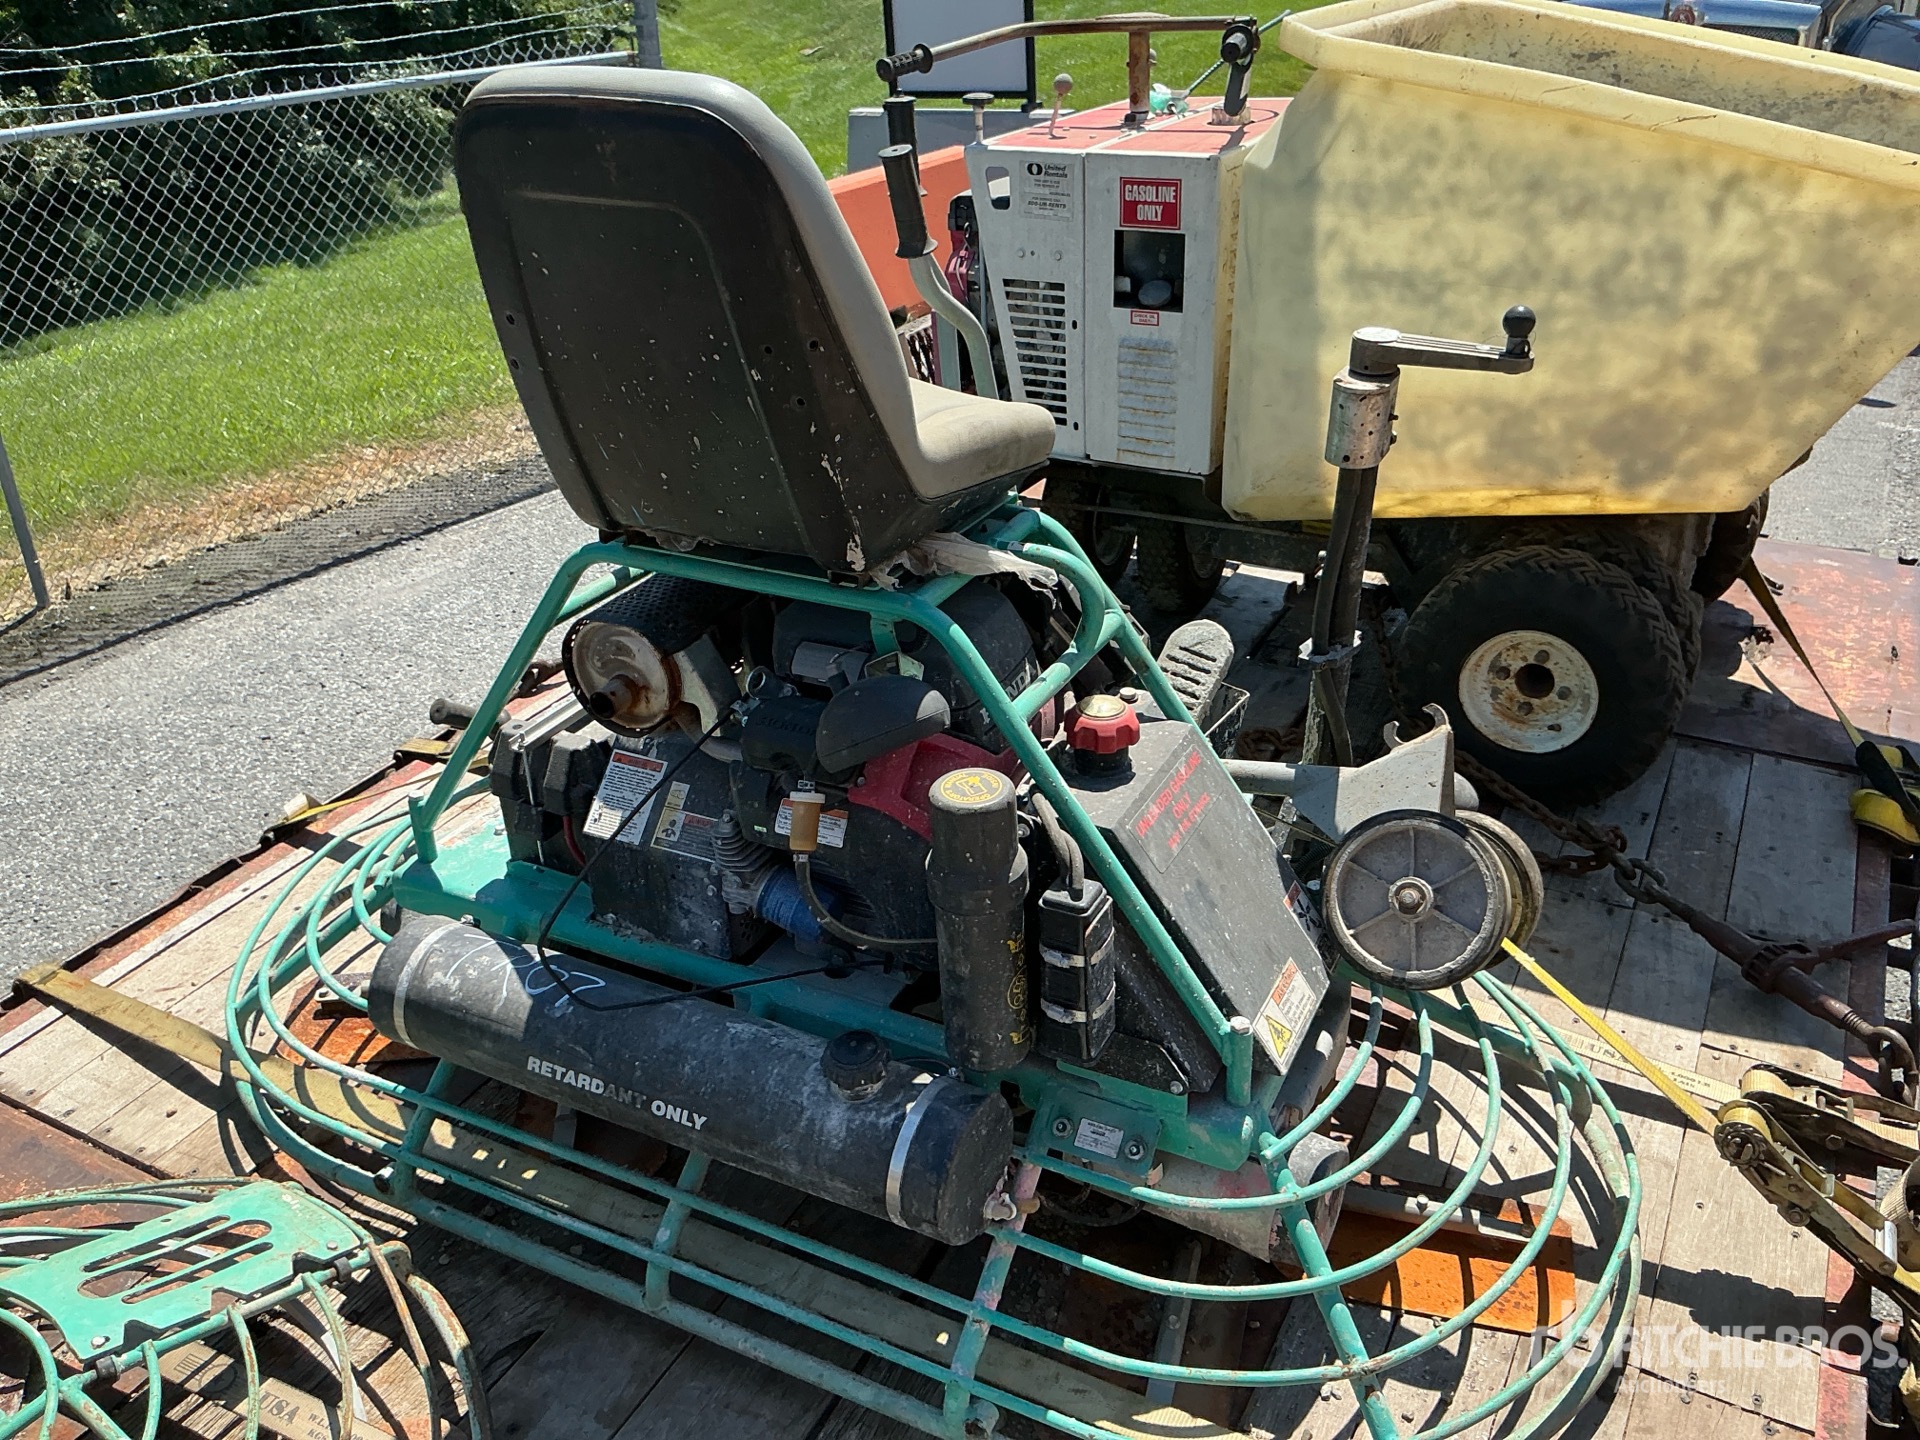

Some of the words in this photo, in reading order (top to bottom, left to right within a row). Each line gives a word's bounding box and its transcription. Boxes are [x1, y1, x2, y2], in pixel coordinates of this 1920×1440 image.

[1043, 170, 1068, 179] Rentals
[1044, 164, 1067, 172] United
[1125, 184, 1176, 203] GASOLINE
[1136, 204, 1164, 222] ONLY
[1135, 787, 1173, 838] UNLEADED
[1169, 750, 1202, 793] GASOLINE
[1172, 791, 1192, 819] ONLY
[526, 1055, 648, 1109] RETARDANT
[650, 1099, 708, 1131] ONLY
[259, 1390, 300, 1426] USA
